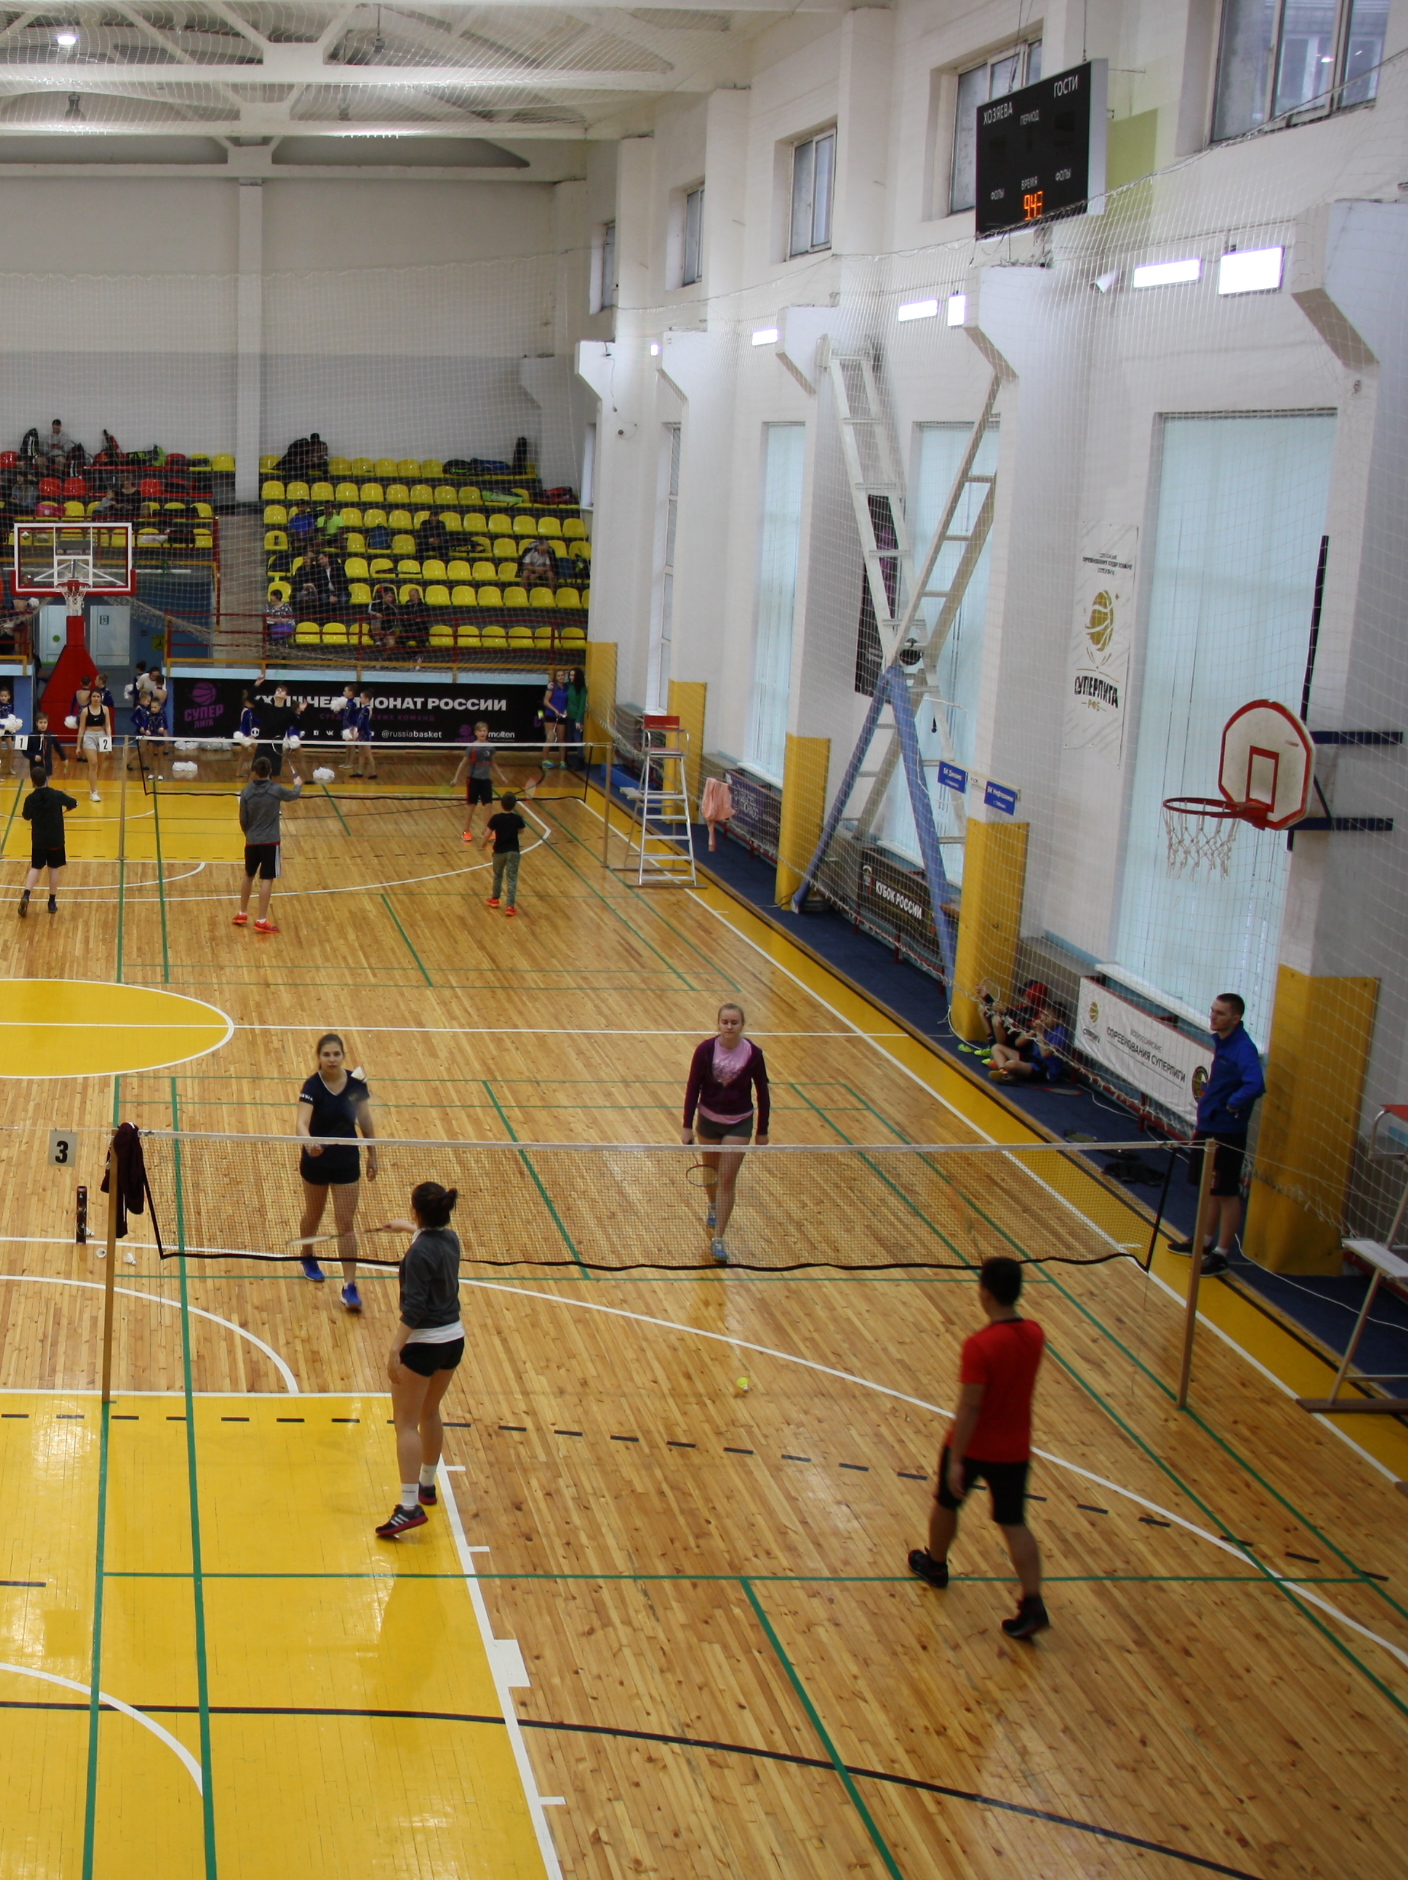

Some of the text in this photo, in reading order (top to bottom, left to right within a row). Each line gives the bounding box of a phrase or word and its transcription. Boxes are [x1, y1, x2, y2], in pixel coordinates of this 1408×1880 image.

[983, 74, 1078, 126] ХОЗЯЕВА ГОСТИ
[1020, 109, 1040, 126] ПЕРИОД
[1055, 168, 1072, 182] ФОЛЫ
[1021, 176, 1038, 190] ВРЕМЯ
[990, 188, 1005, 201] ФОЛЫ
[1074, 675, 1119, 708] СУПЕРЛИГА
[427, 698, 507, 711] РОССИИ
[184, 704, 224, 722] СУПЕР
[194, 719, 214, 728] ЛИГА
[381, 730, 442, 738] @russiabasket
[20, 738, 24, 748] 1
[103, 739, 108, 750] 2
[875, 880, 922, 920] КУБОК РОССИИ
[1106, 1026, 1186, 1083] СОРЕВНОВАНИЯ СУПЕРЛИГИ
[55, 1140, 68, 1163] 3
